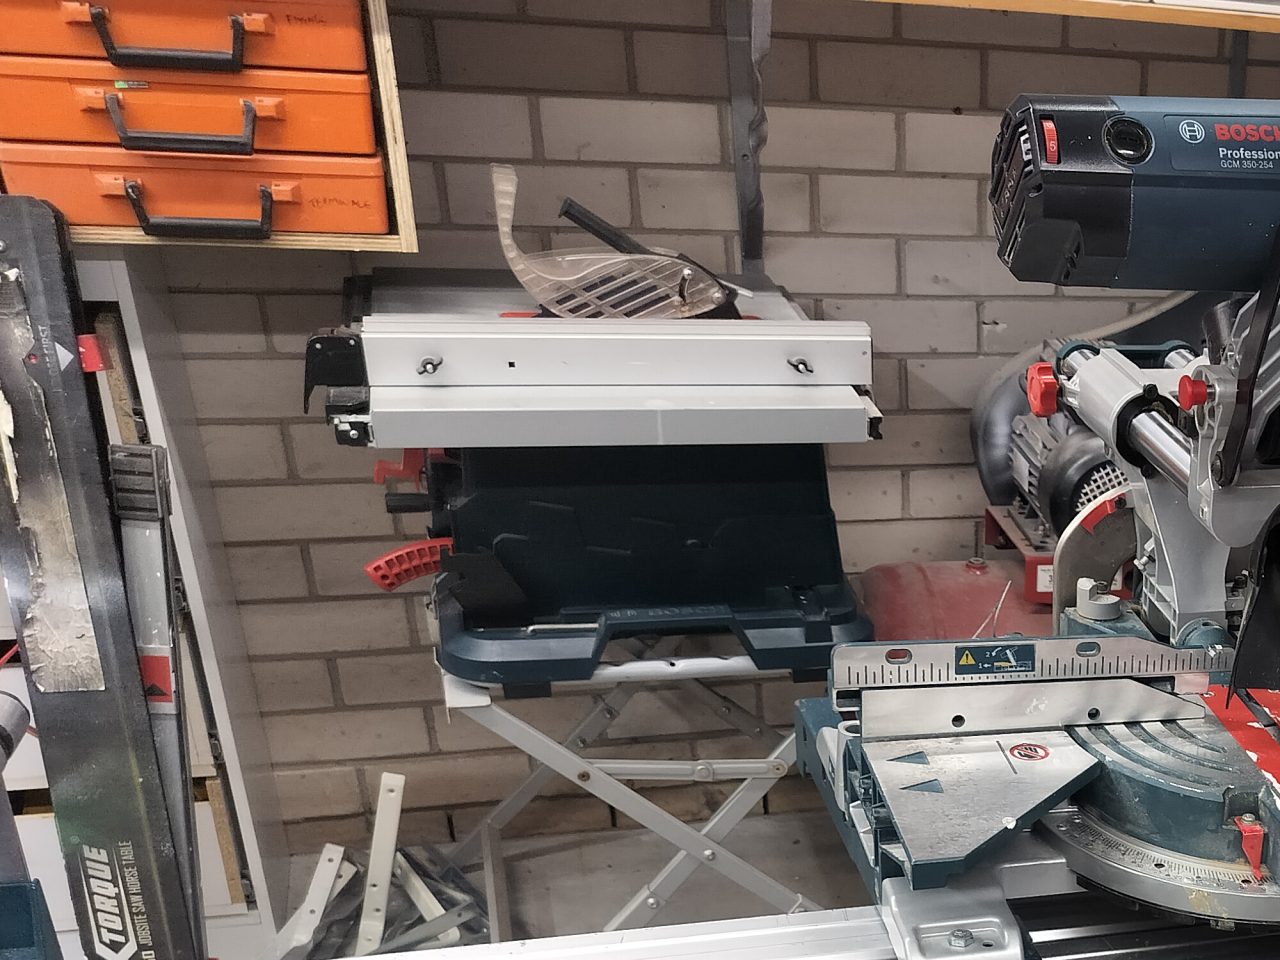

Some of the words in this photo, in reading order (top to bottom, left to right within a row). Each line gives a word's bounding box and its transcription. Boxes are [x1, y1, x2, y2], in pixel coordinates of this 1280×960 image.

[1220, 160, 1240, 169] GCM
[1241, 160, 1274, 169] 350-254
[118, 840, 136, 865] TABLE
[124, 865, 142, 894] HORSE
[131, 894, 146, 913] SAW
[134, 913, 153, 946] JOBSITE
